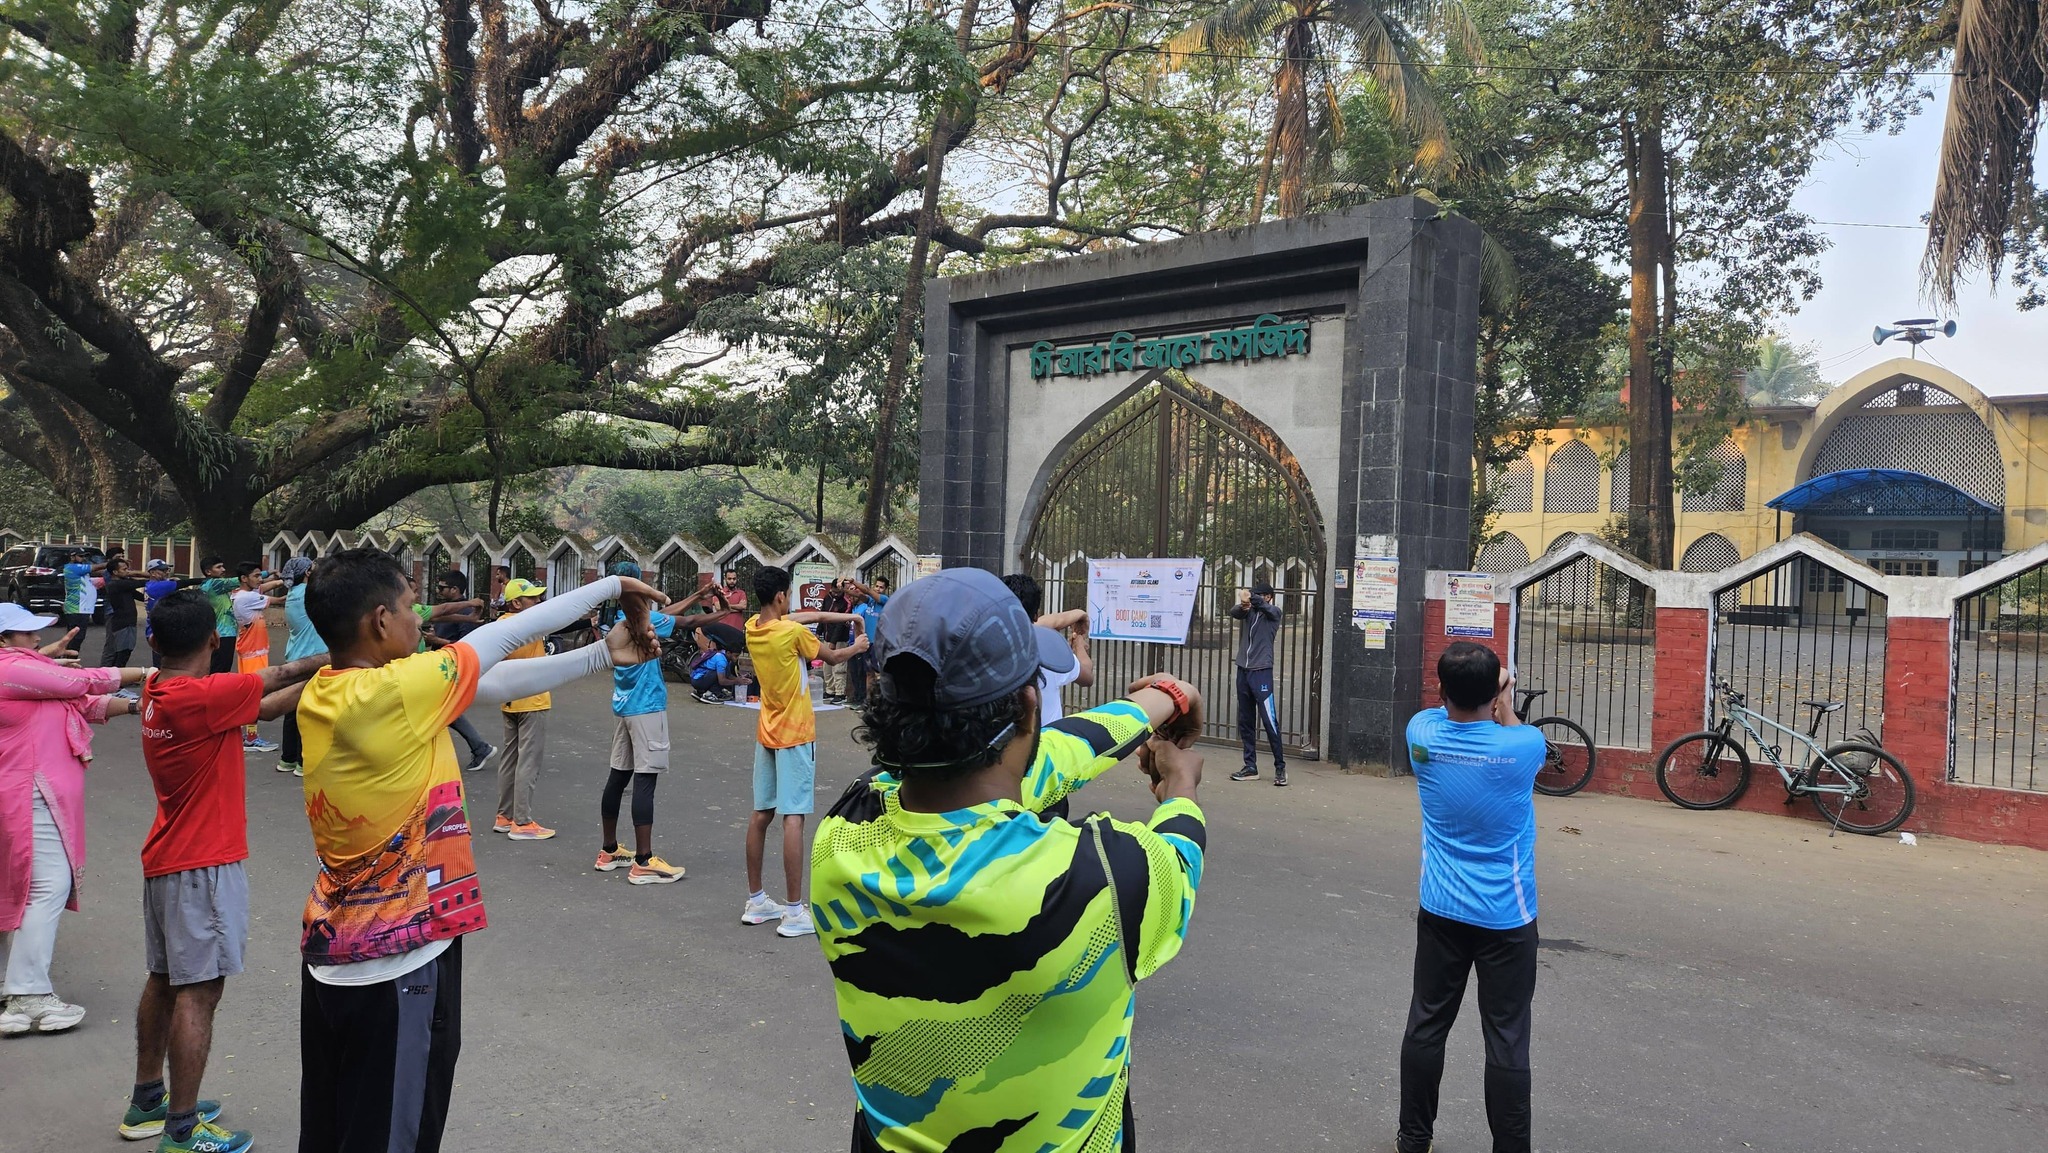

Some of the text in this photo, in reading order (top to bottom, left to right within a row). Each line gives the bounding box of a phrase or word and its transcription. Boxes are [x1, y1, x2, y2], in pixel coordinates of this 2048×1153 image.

[1030, 313, 1308, 379] সি আর বি জামে মসজিদ
[1116, 610, 1148, 622] BOOT CAMP
[1744, 726, 1782, 769] MERIDA
[1435, 752, 1517, 764] ActivePulse
[1435, 757, 1484, 767] BANGLADESH
[406, 984, 429, 995] PSE
[192, 1139, 231, 1153] HOKA
